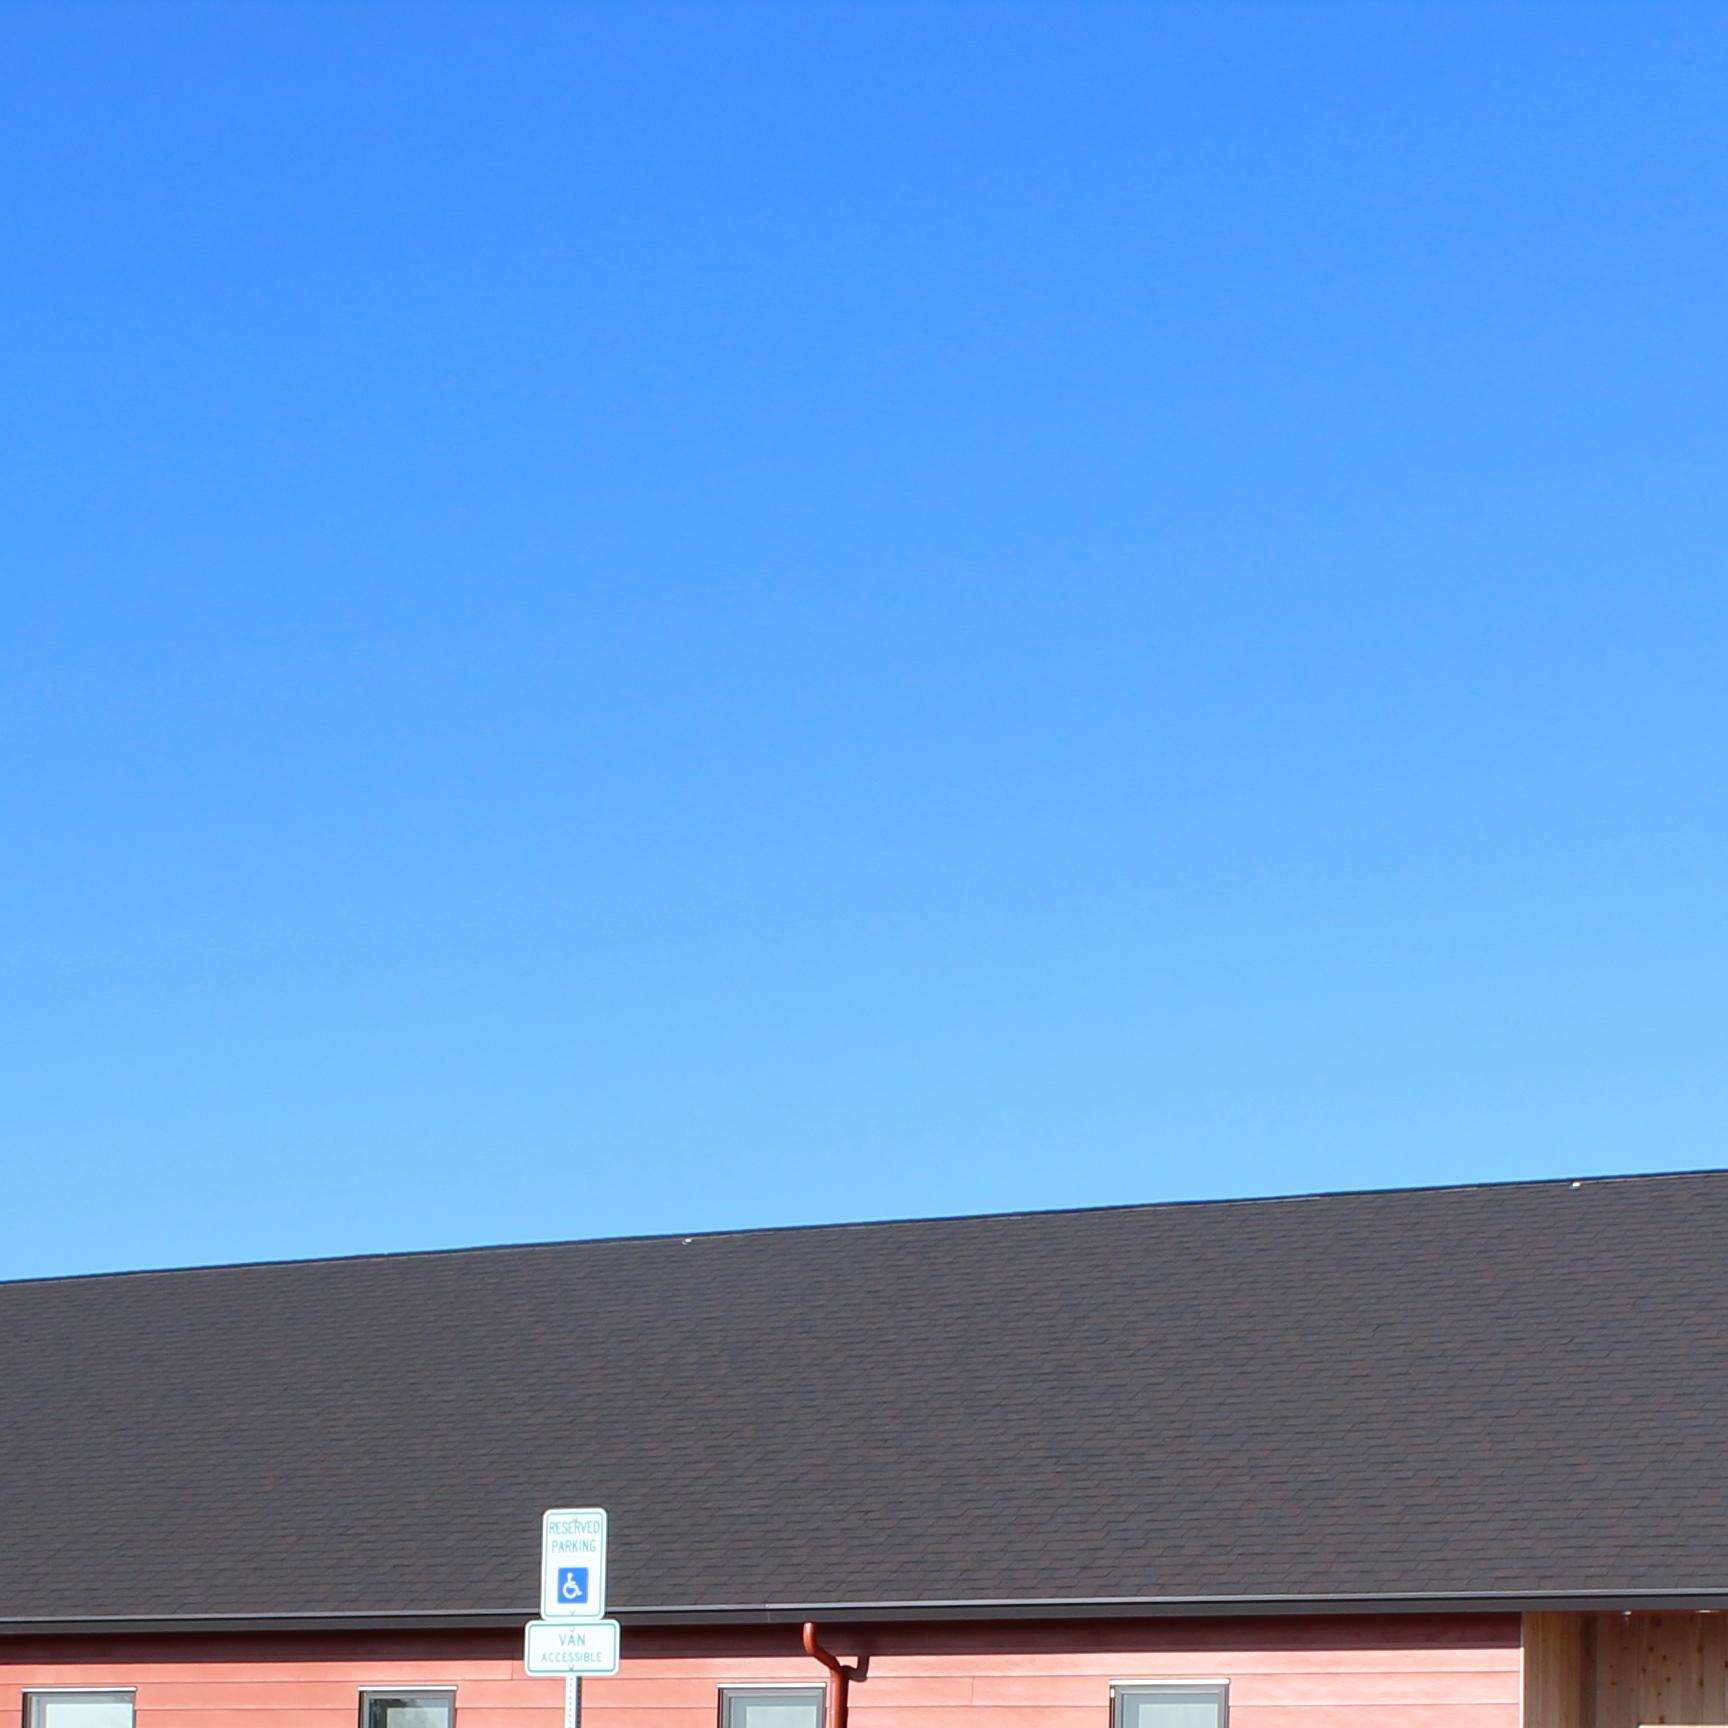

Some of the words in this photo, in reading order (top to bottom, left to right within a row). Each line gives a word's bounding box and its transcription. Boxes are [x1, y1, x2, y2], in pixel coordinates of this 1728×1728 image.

[548, 1520, 601, 1535] RESERVED
[551, 1539, 597, 1553] PARKING
[558, 1632, 586, 1647] VAN
[540, 1651, 604, 1663] ACCESSIBLE
